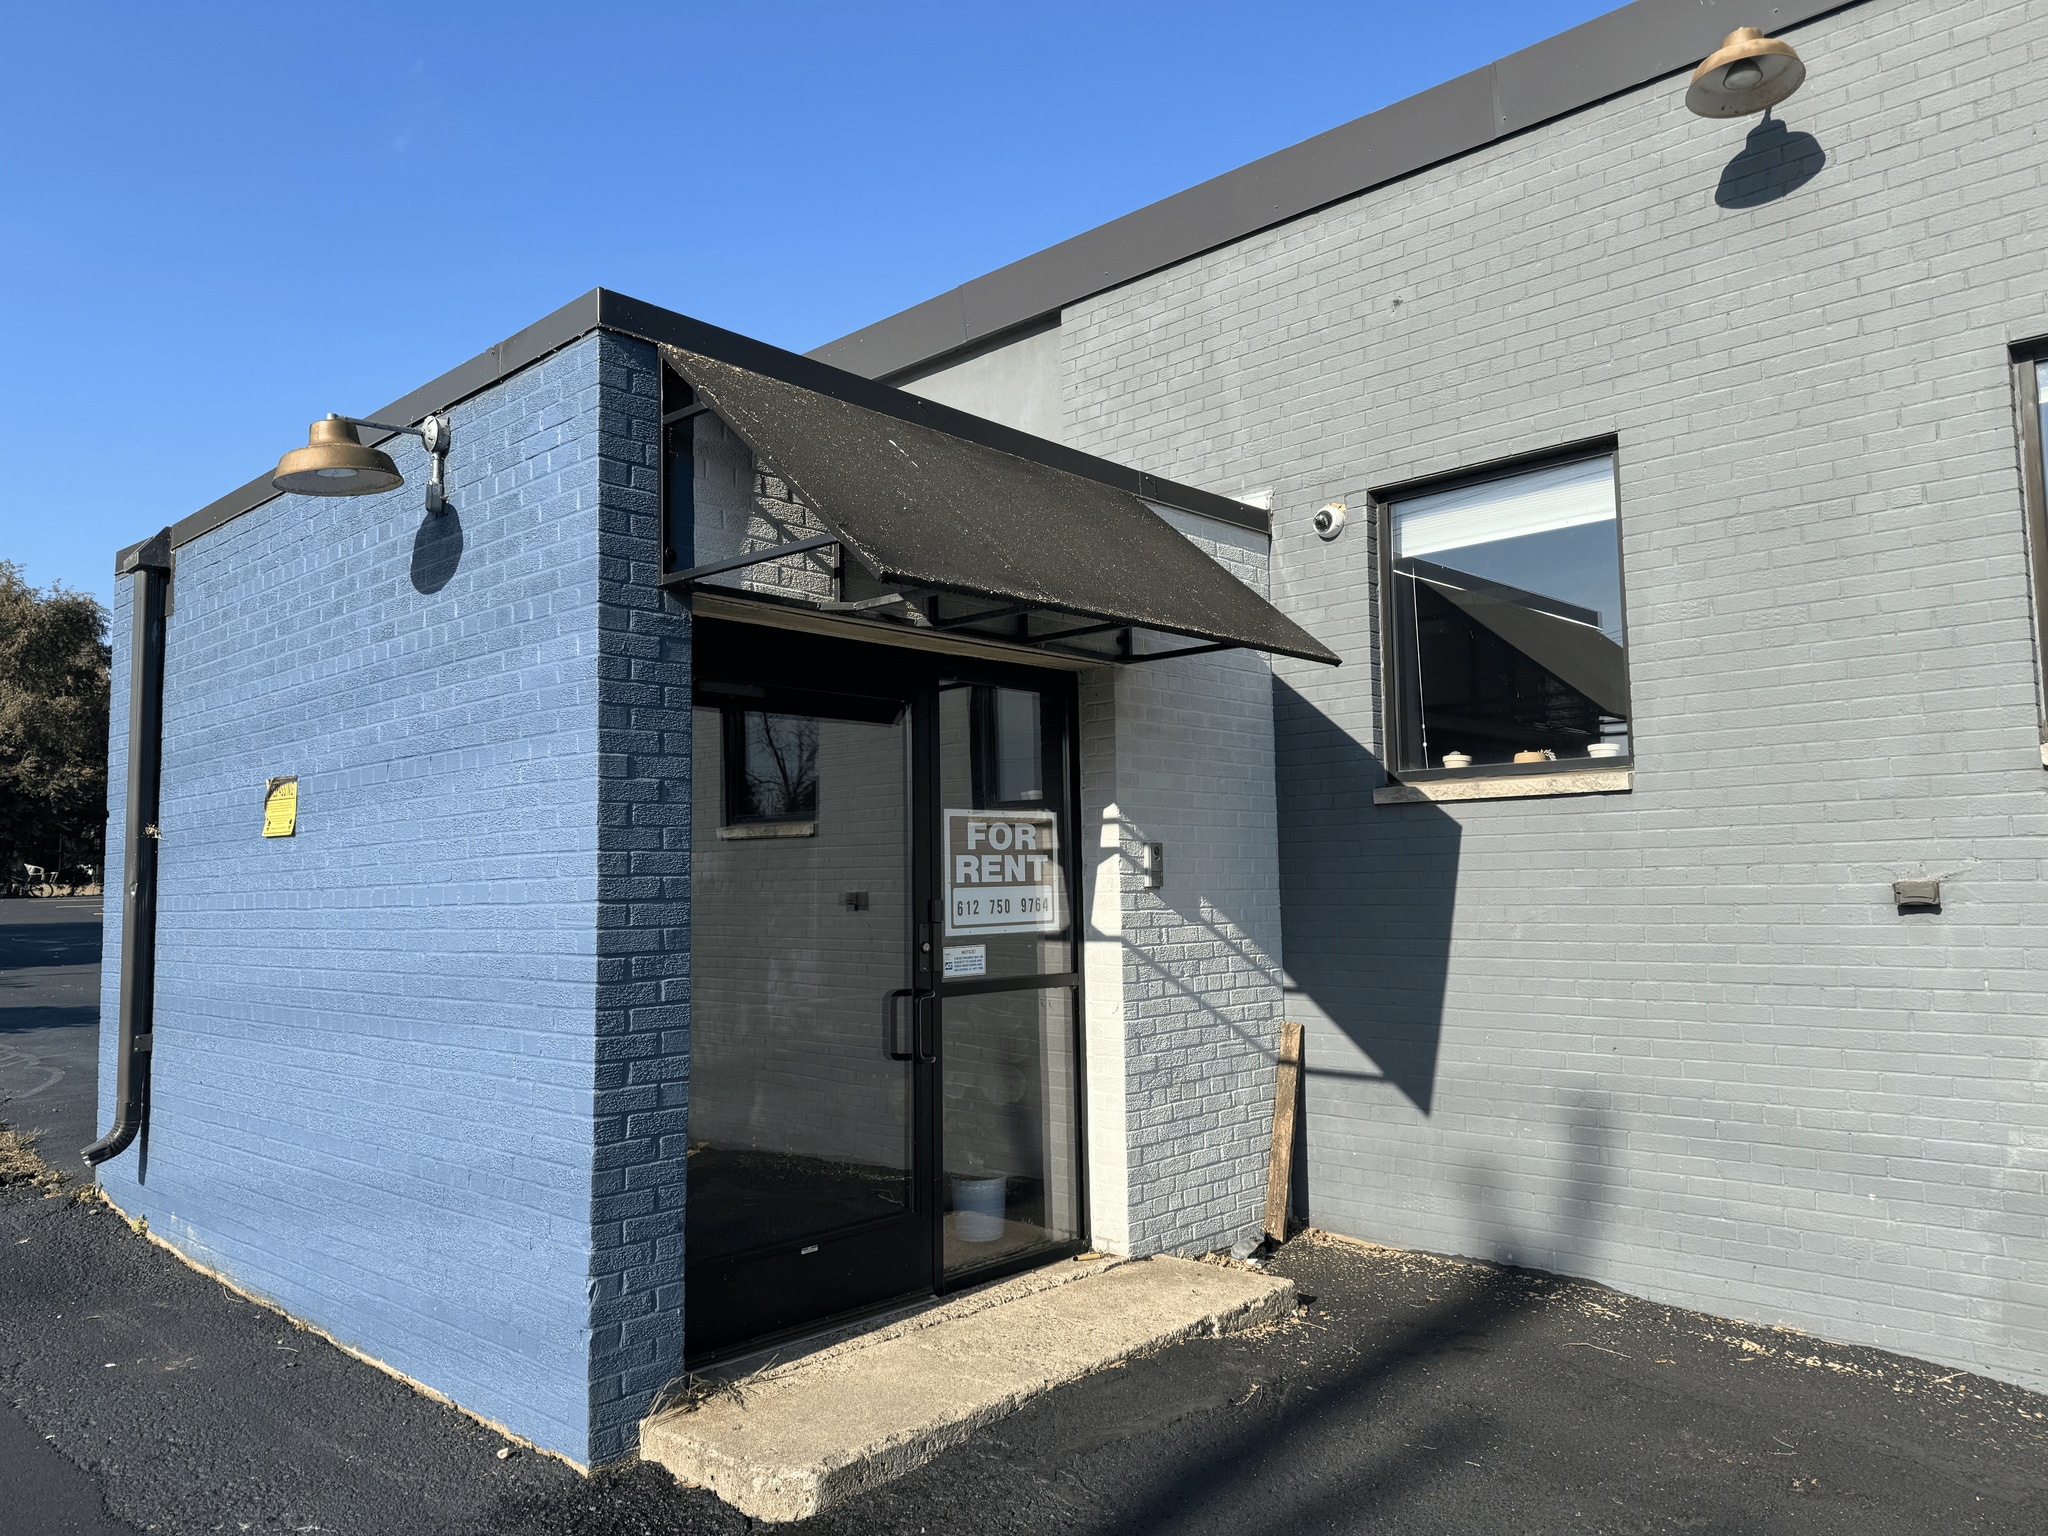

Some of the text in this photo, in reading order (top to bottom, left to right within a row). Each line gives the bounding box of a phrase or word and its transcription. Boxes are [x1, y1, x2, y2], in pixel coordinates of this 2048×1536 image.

[967, 822, 1037, 851] FOR
[955, 854, 1049, 884] RENT
[957, 897, 1049, 916] 612 750 9764
